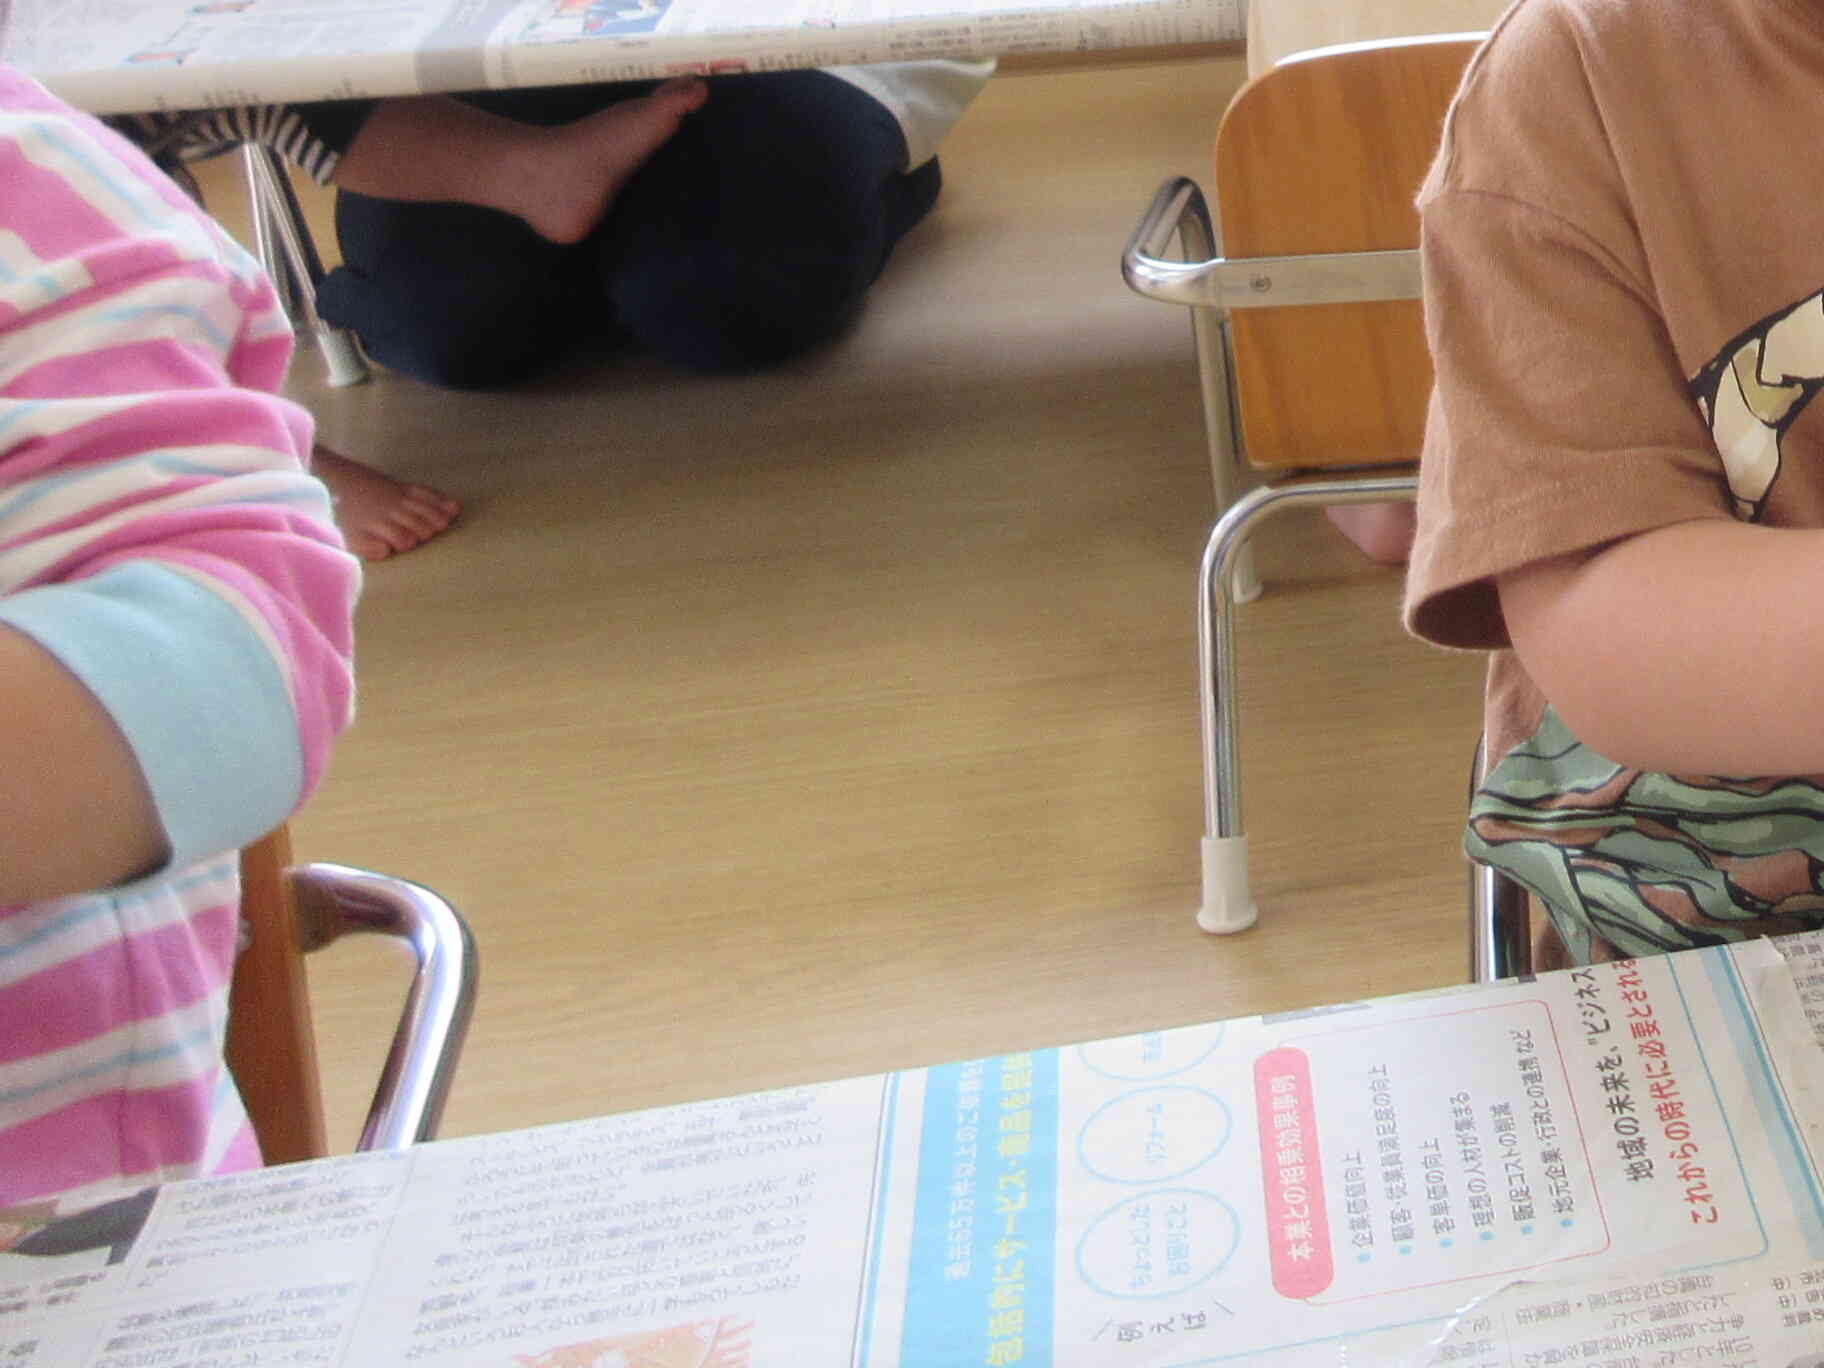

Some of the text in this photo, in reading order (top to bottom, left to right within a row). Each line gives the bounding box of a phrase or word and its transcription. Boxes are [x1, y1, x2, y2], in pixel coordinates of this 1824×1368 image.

[1518, 1029, 1575, 1214] 地元企業・行政との連携 など
[1611, 958, 1721, 1225] これからの時代に必要とされる
[1271, 1074, 1313, 1262] 本業との相乗効果事例
[1343, 1151, 1374, 1249] 企業価値向上
[1369, 1064, 1415, 1243] 顧客・従業員満足度の向上
[1418, 1137, 1456, 1235] 客単価の向上
[1450, 1091, 1495, 1229] 理想の人材が集まる
[1489, 1101, 1535, 1224] 販促コストの削減
[1130, 1203, 1152, 1289] ちょっとした
[1166, 1201, 1191, 1277] お困りごと
[1116, 1310, 1207, 1344] 例えば
